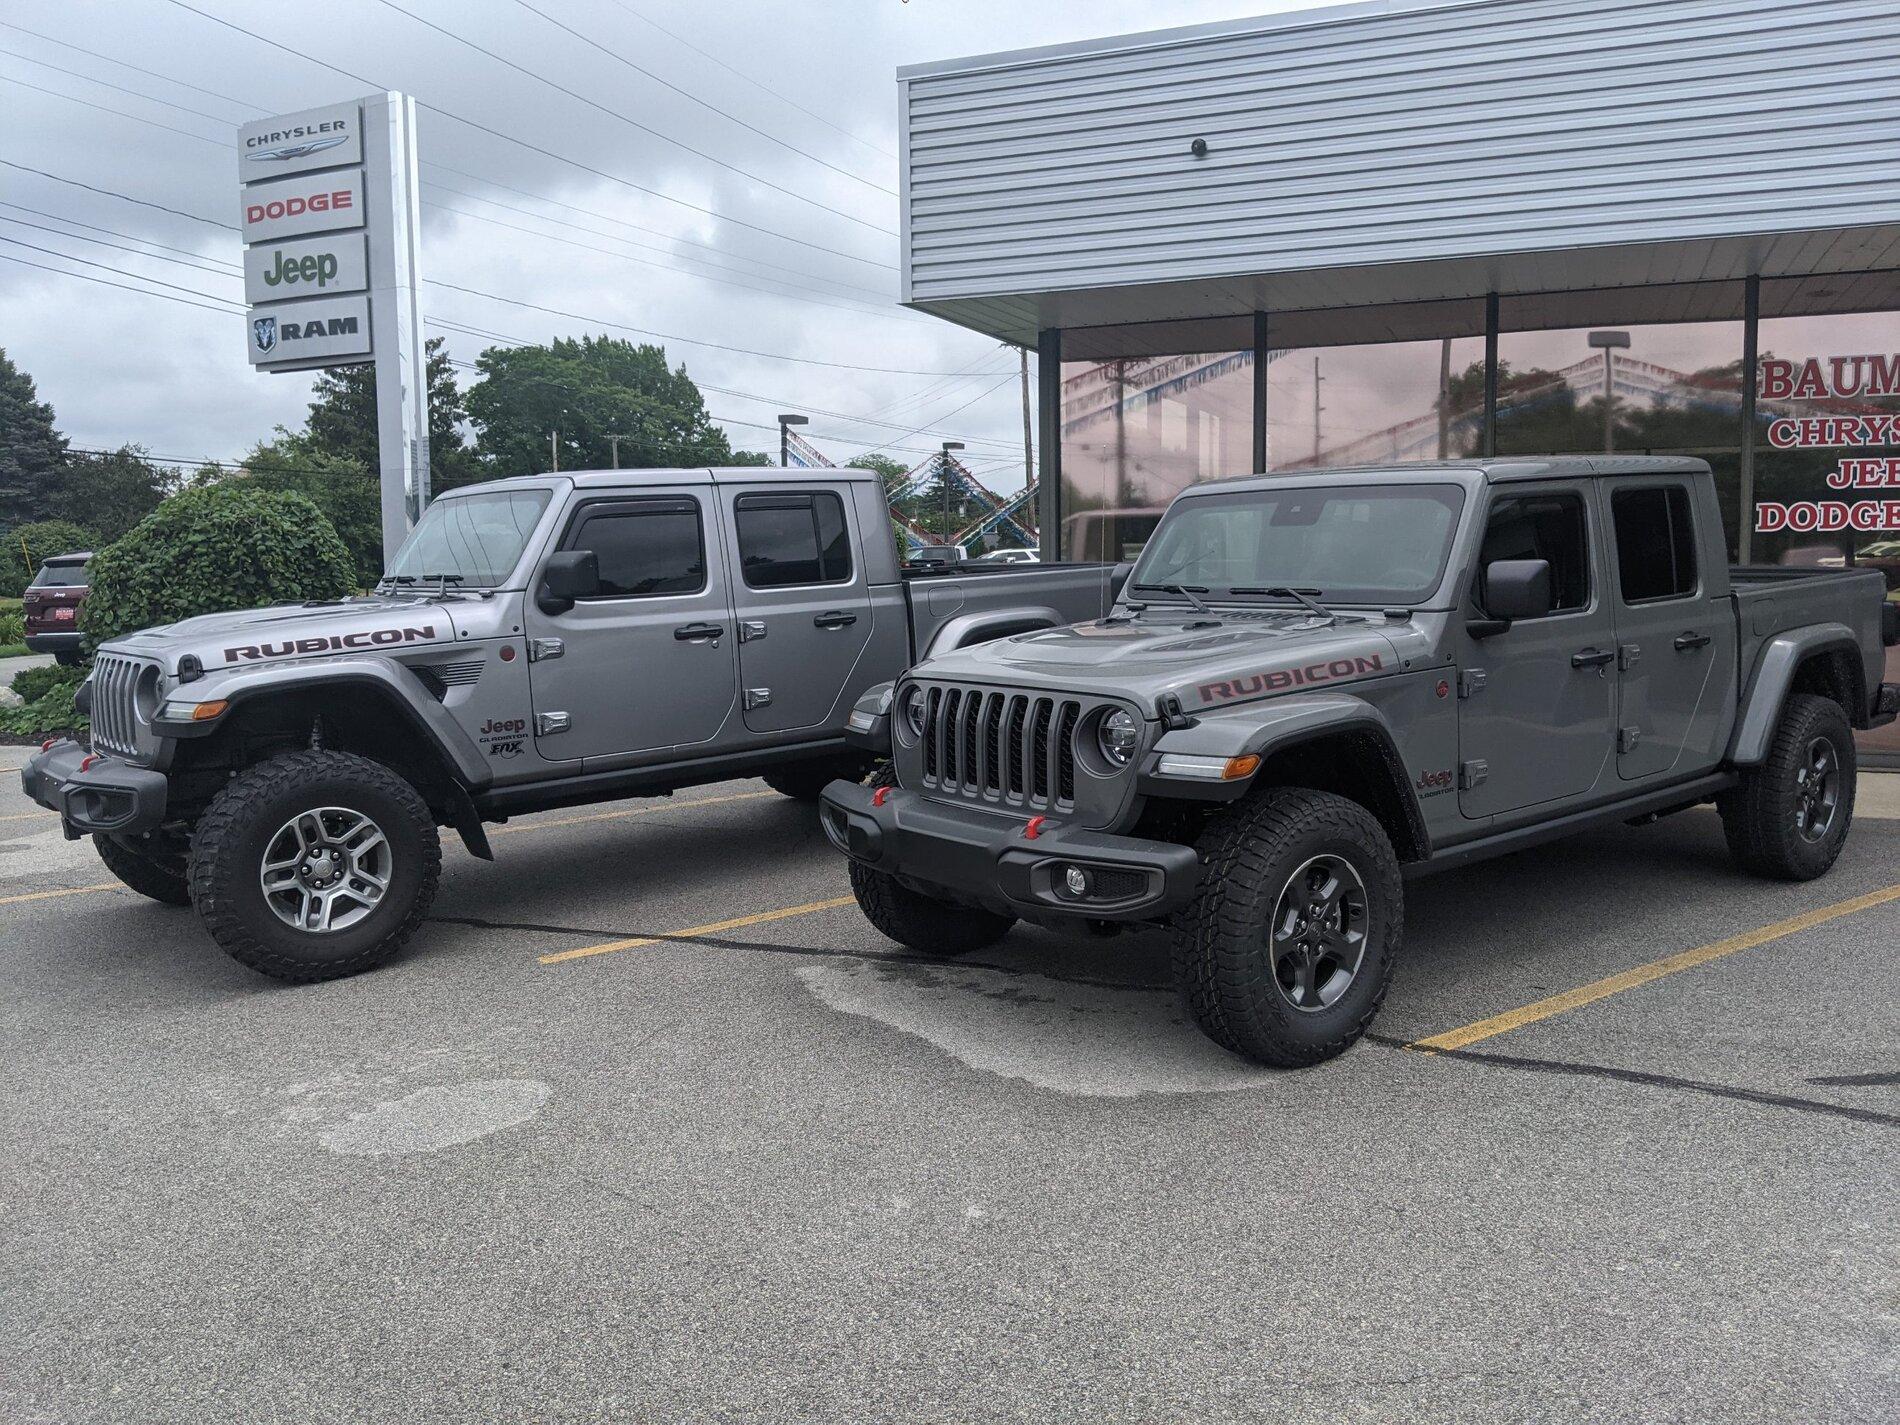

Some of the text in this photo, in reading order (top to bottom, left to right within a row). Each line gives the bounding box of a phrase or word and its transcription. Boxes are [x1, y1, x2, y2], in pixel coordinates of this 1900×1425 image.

[247, 120, 346, 148] CHRYSLER
[247, 190, 353, 224] DODGE
[264, 250, 338, 287] Jeep
[280, 316, 358, 341] RAM
[1755, 500, 1900, 532] DODGE
[223, 625, 436, 663] RUBICON
[1198, 655, 1383, 701] RUBICON
[480, 718, 526, 734] Jeep
[1416, 768, 1453, 790] Jeep
